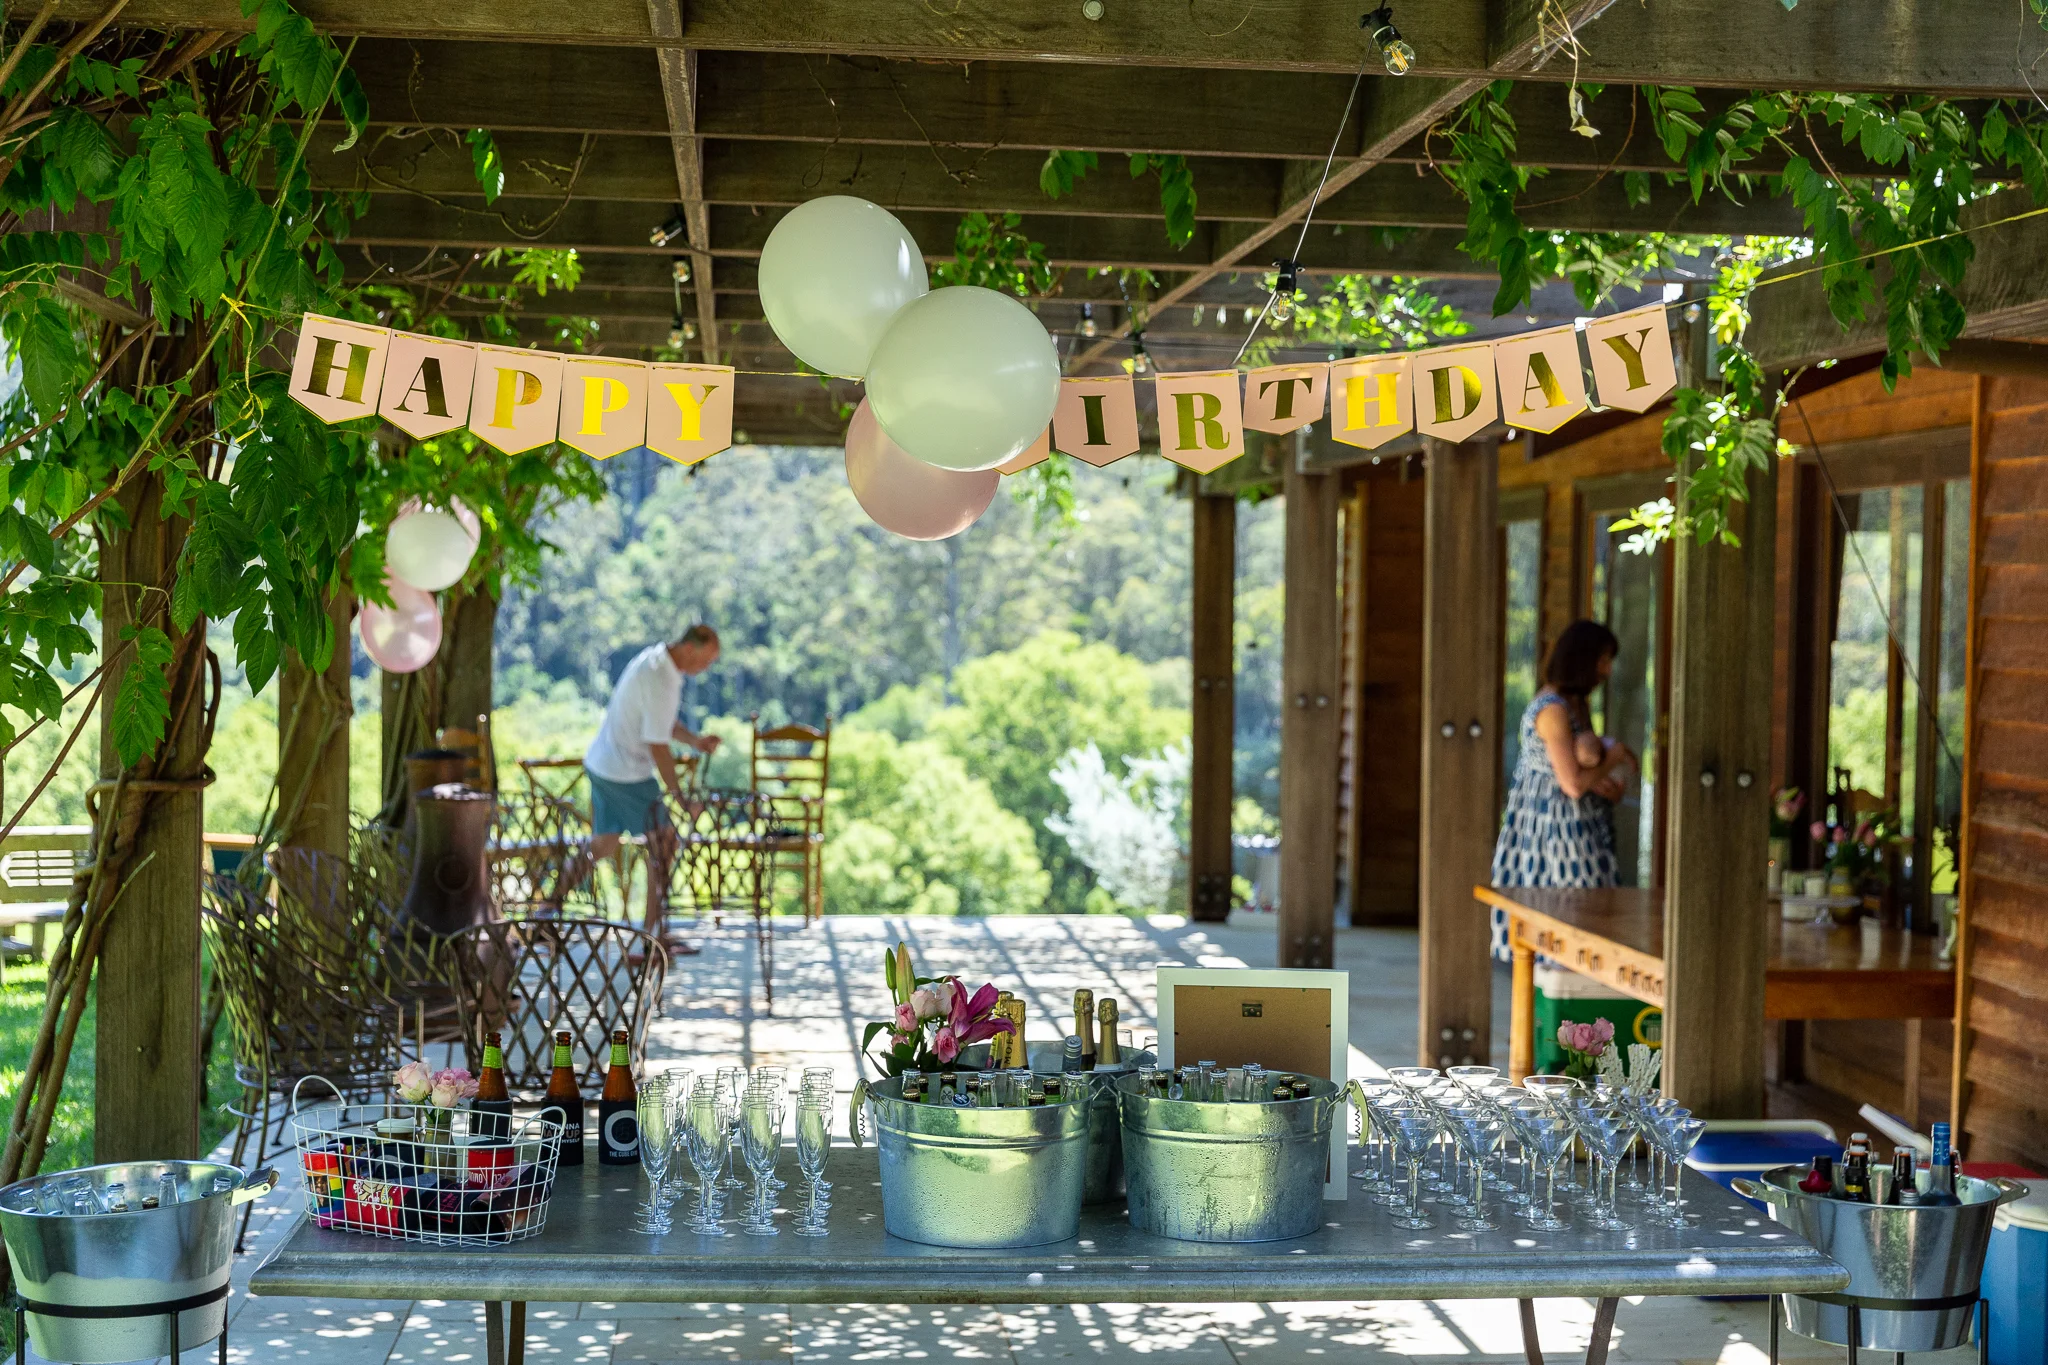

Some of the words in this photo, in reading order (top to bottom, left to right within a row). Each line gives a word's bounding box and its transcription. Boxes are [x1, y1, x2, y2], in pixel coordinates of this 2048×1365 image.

[301, 335, 719, 442] HAPPY
[1078, 327, 1652, 451] IRTHDAY
[609, 1150, 618, 1158] THE
